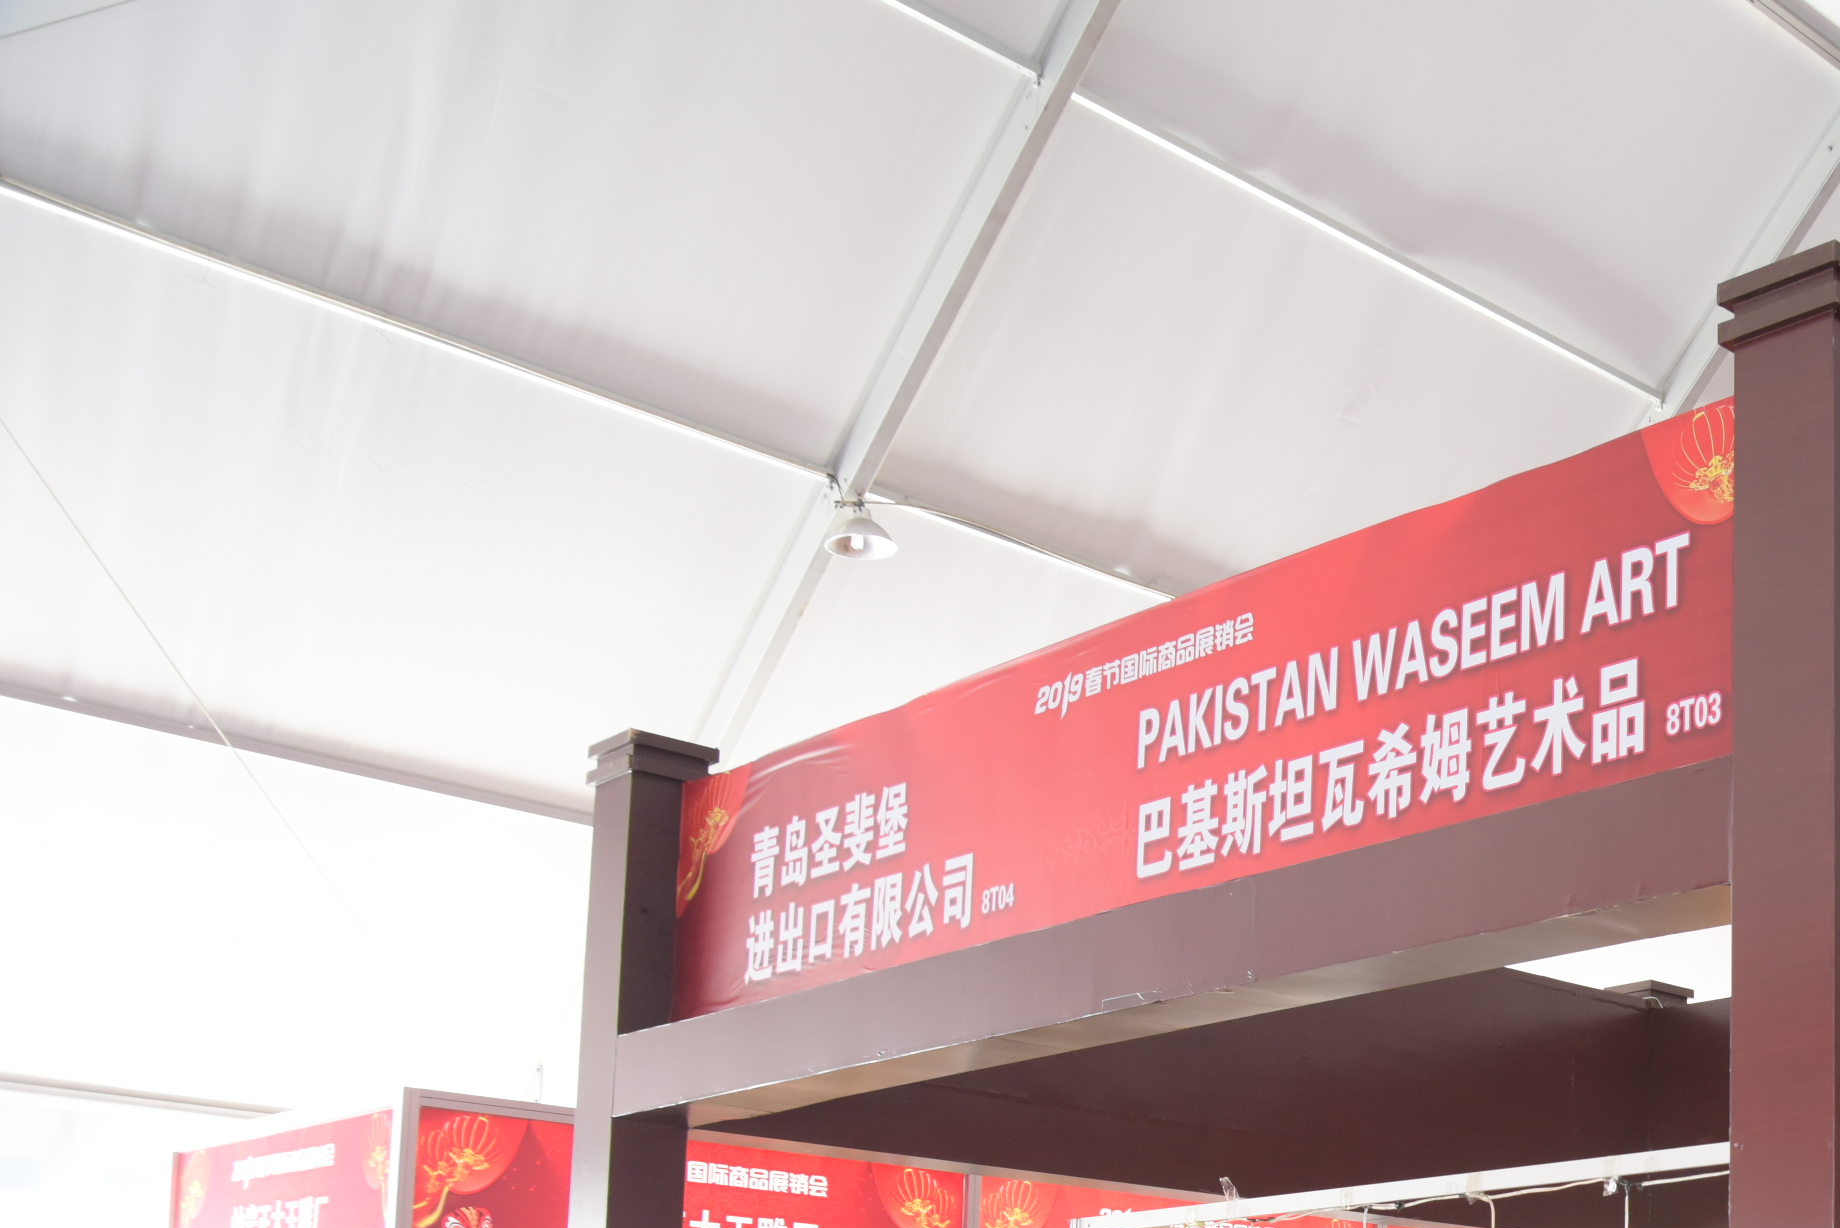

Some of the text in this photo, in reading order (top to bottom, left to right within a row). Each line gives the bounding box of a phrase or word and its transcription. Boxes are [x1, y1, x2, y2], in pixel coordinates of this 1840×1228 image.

[1034, 612, 1254, 719] 2019春节国际商品展销会
[1137, 532, 1691, 770] PAKISTAN WASEEM ART
[1136, 658, 1722, 880] 巴基斯坦瓦希姆艺术品 8T03
[751, 782, 909, 899] 青岛圣斐堡
[744, 853, 1015, 985] 进出口有限公司 8T04
